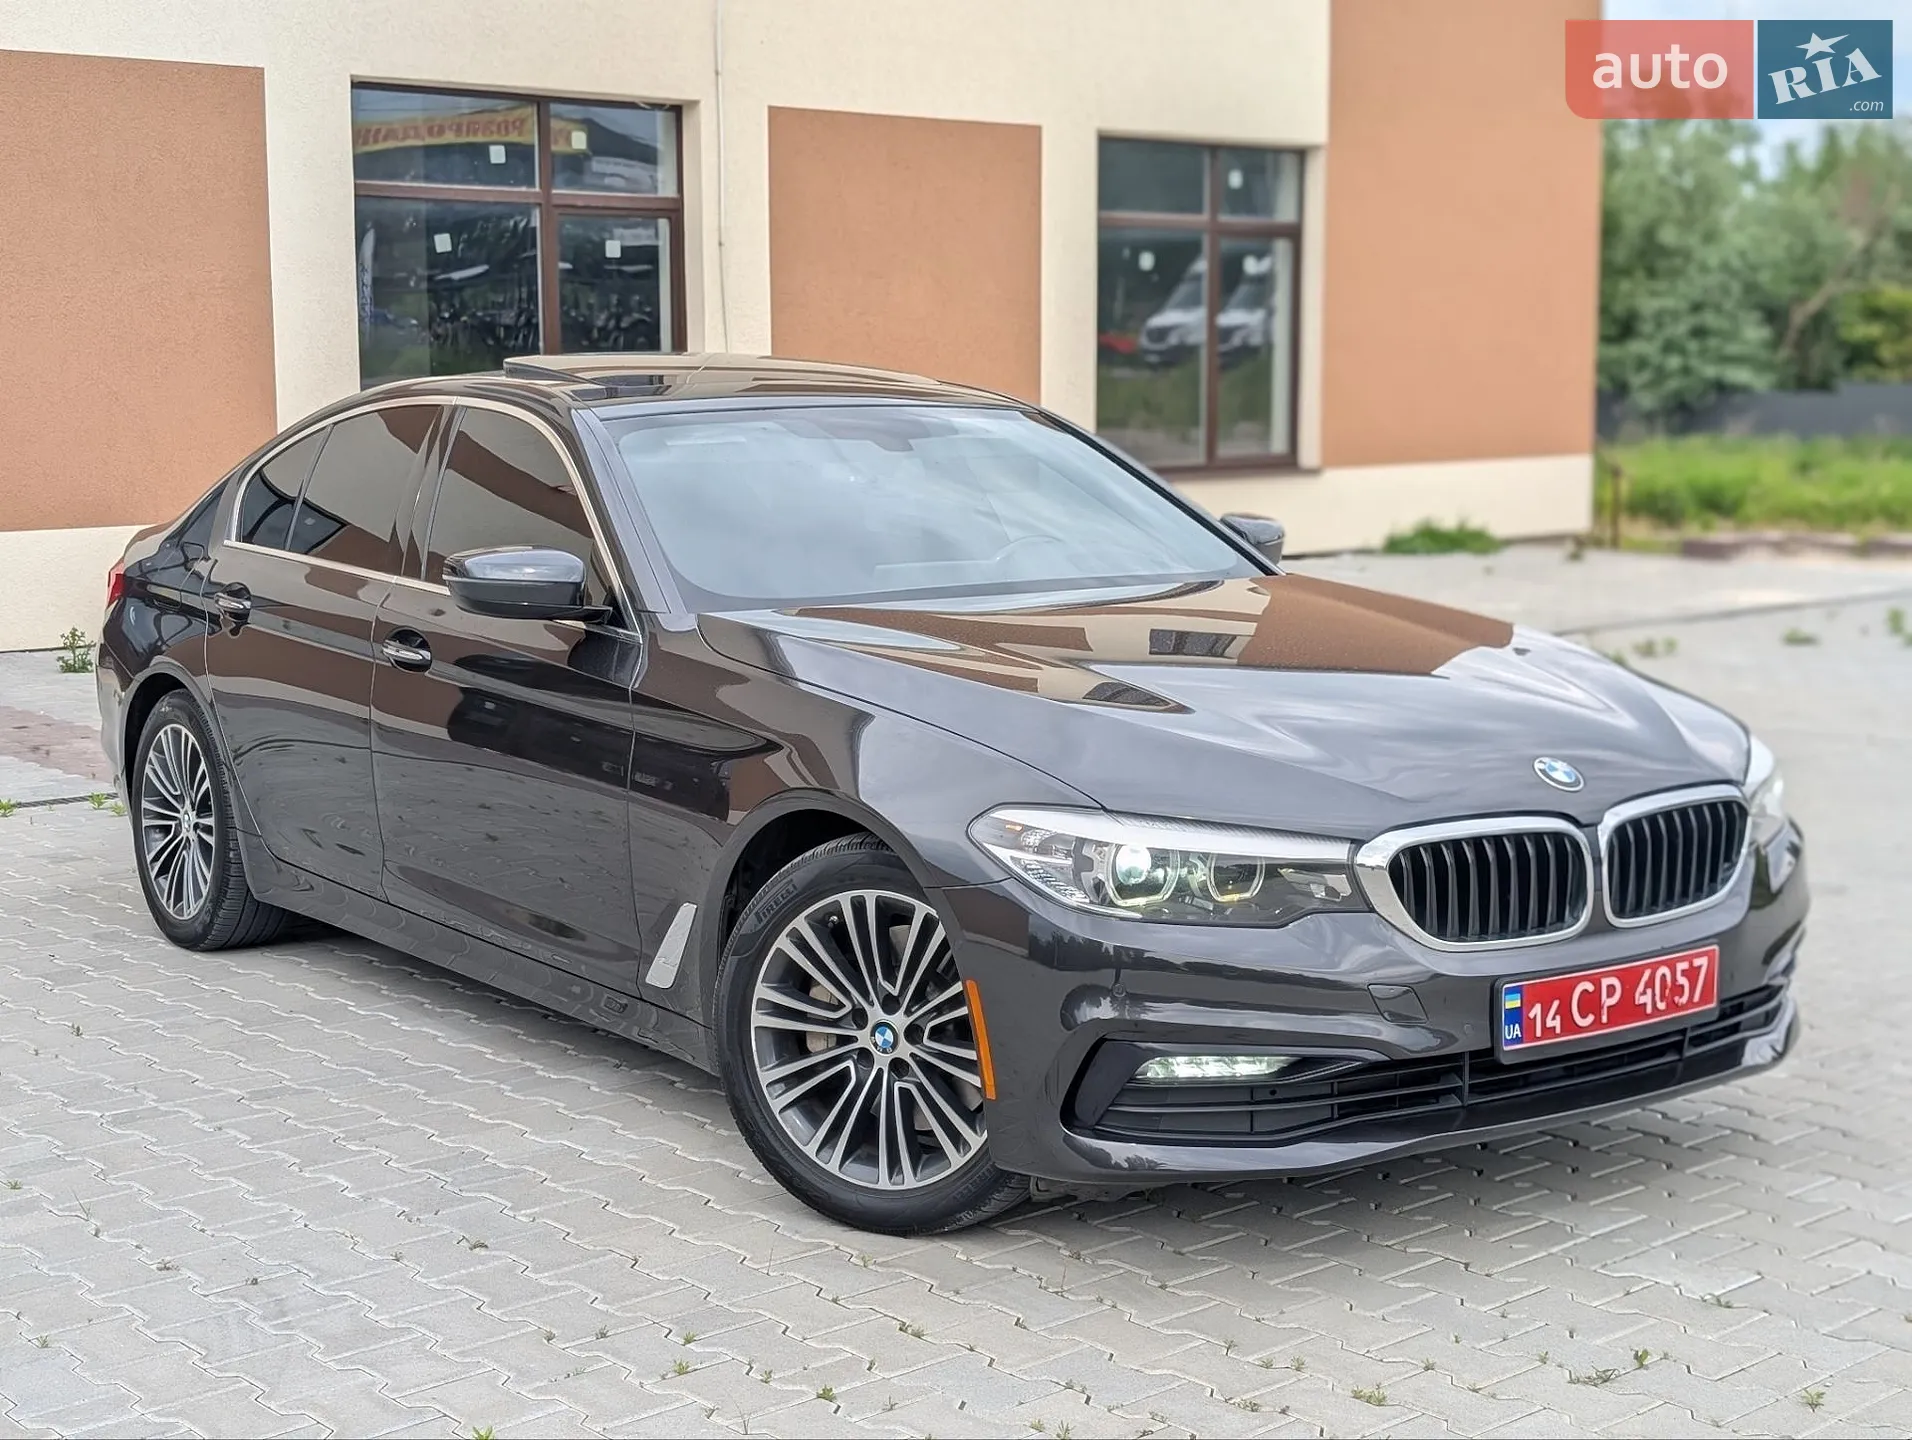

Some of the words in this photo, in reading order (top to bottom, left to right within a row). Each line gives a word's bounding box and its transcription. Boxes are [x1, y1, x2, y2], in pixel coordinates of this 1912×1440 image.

[1528, 999, 1562, 1038] 14
[1571, 976, 1622, 1027] CP
[1634, 956, 1709, 1014] 4057
[1504, 1024, 1522, 1040] UA
